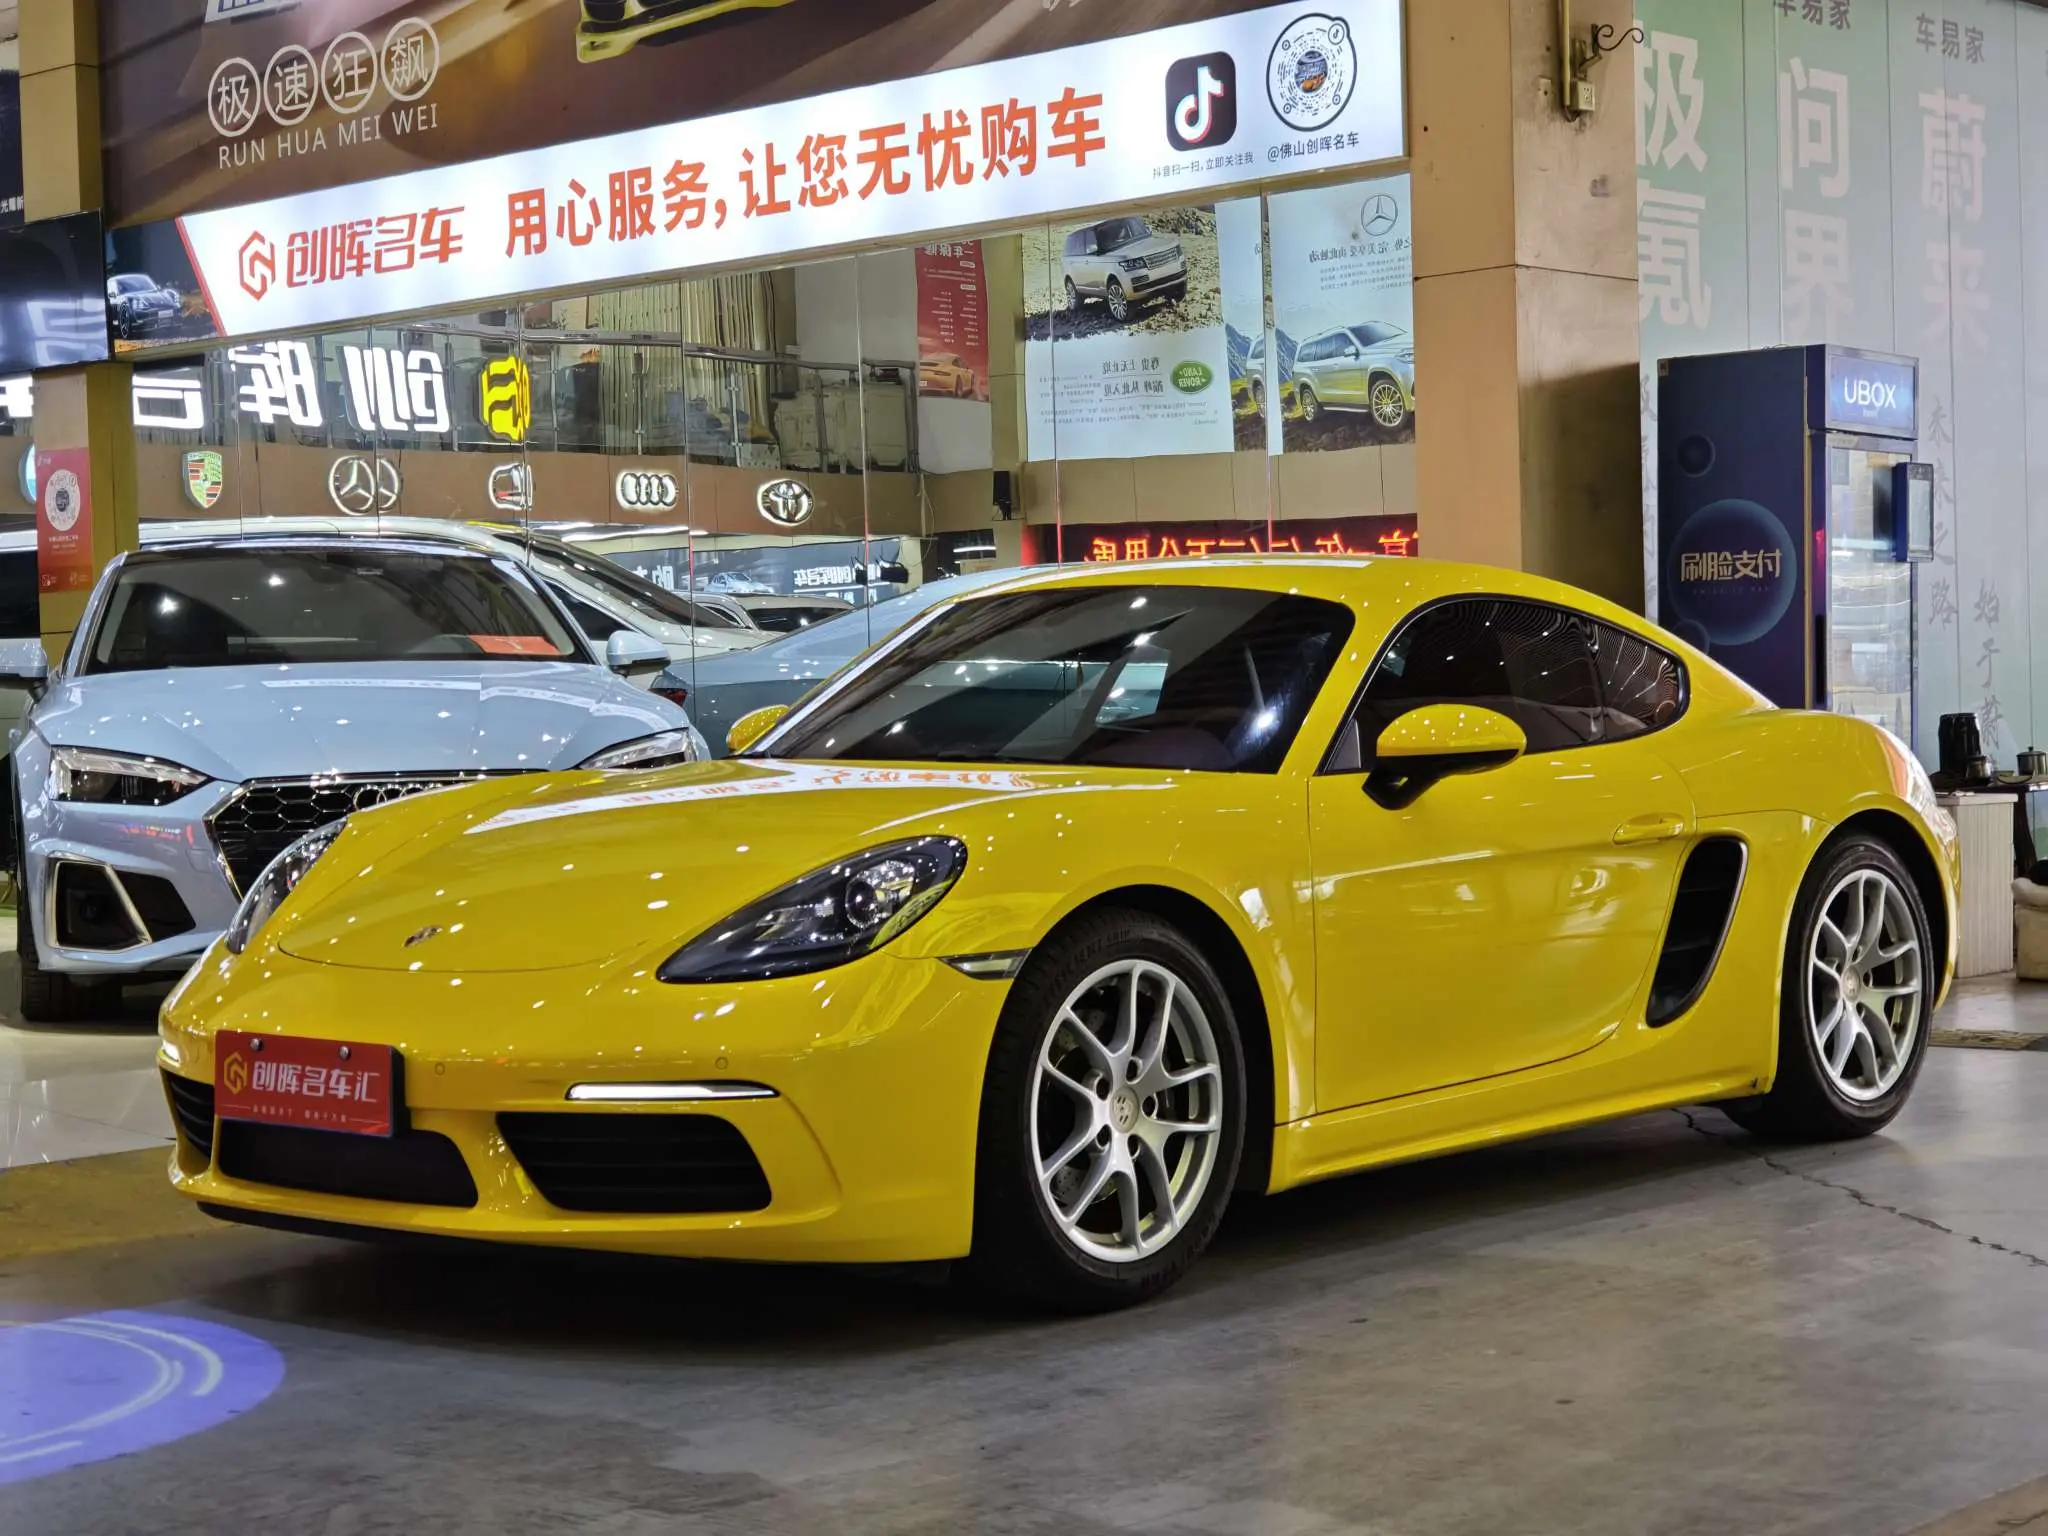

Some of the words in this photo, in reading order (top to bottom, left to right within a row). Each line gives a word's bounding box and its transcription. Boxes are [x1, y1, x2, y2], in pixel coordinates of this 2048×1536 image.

[1915, 12, 1986, 64] 车易家
[215, 34, 430, 127] 极速狂飙
[219, 138, 265, 169] RUN
[278, 127, 327, 158] HUA
[338, 114, 381, 147] MEI
[392, 103, 438, 136] WEI
[1267, 130, 1360, 164] @佛山创晖名车
[1777, 56, 1854, 345] 问界
[1917, 87, 1992, 356] 蔚来
[286, 206, 466, 289] 创晖名车
[1844, 376, 1897, 409] UBOX
[1680, 549, 1783, 583] 刷脸支付
[252, 1060, 381, 1103] 创晖名车汇
